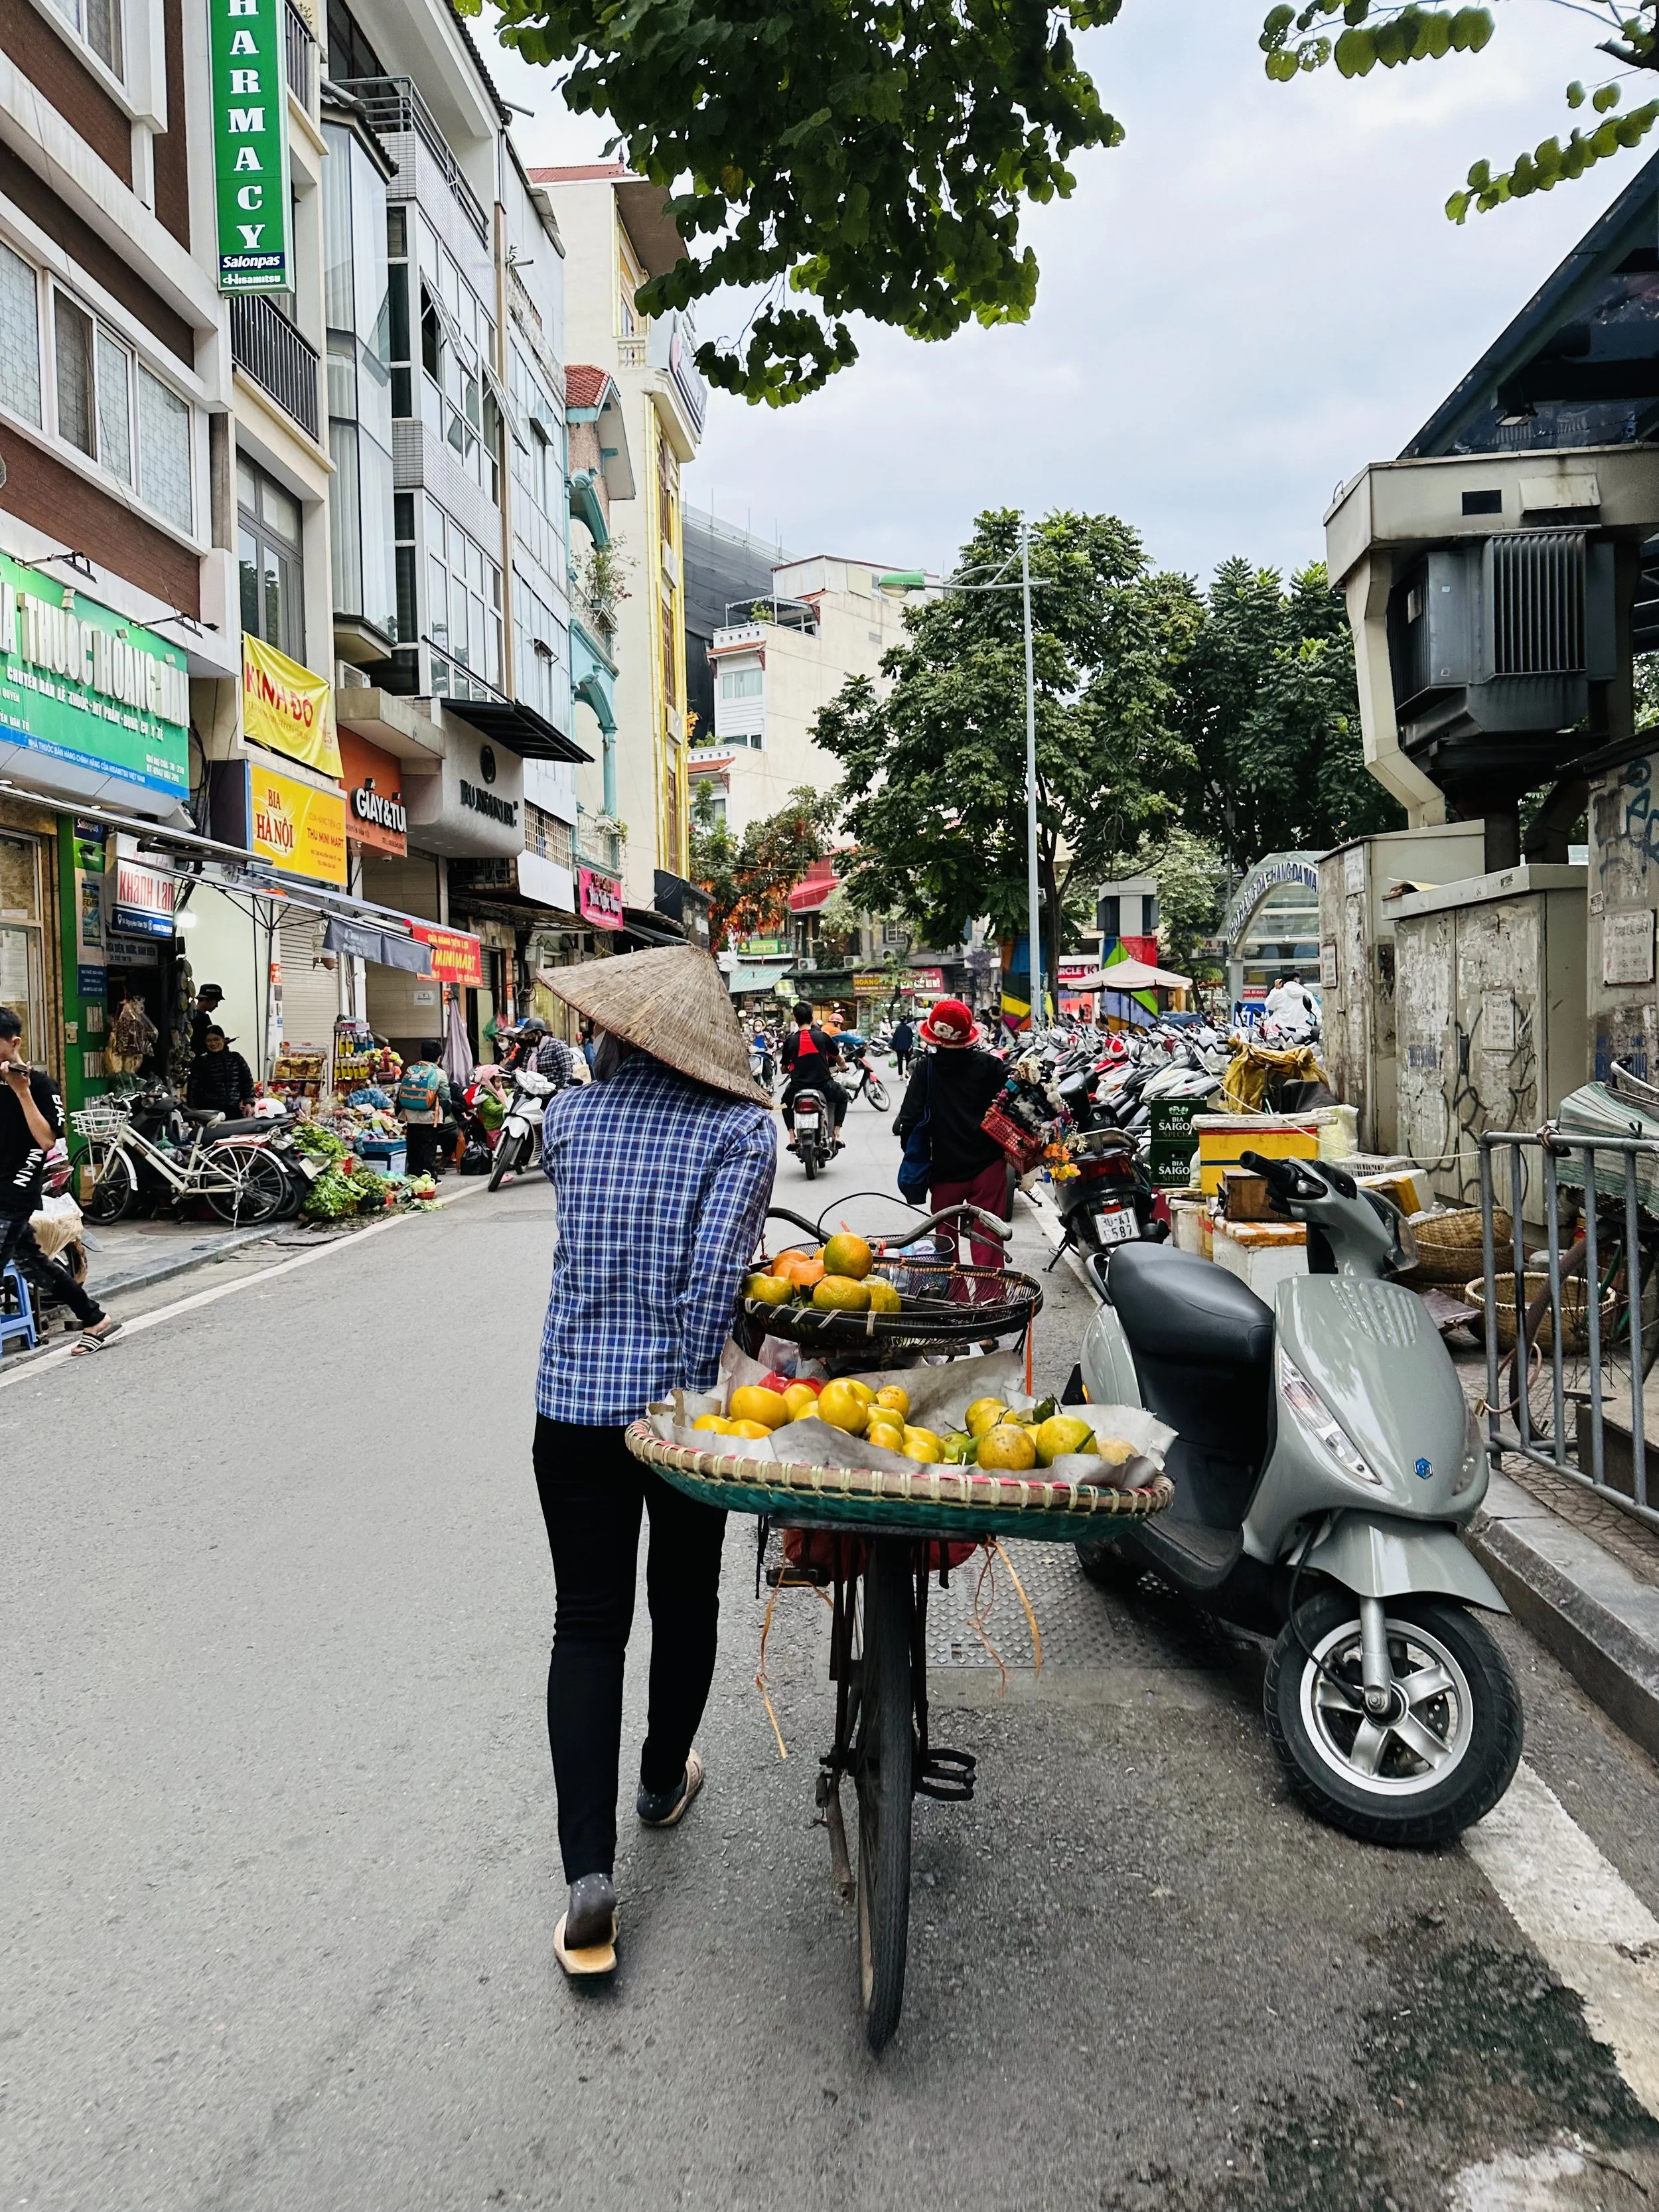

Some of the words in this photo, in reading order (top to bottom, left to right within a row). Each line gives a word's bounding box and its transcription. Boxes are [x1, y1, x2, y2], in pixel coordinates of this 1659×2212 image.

[228, 0, 265, 249] HARMACY
[222, 256, 280, 268] Salonpas
[222, 273, 281, 285] Hisamitsu
[246, 662, 287, 714] KINH
[290, 690, 314, 728] ĐÔ
[268, 788, 281, 810] BIA
[256, 809, 273, 843] HÀ
[273, 817, 293, 853] NỘI
[307, 827, 317, 841] THU
[319, 832, 330, 845] MINI
[330, 836, 344, 849] MART
[1058, 966, 1082, 975] RCLE
[13, 1149, 44, 1187] MAIN
[1158, 1166, 1190, 1175] SAIGO
[1101, 1211, 1130, 1227] 30-K1
[1104, 1224, 1132, 1241] 6587
